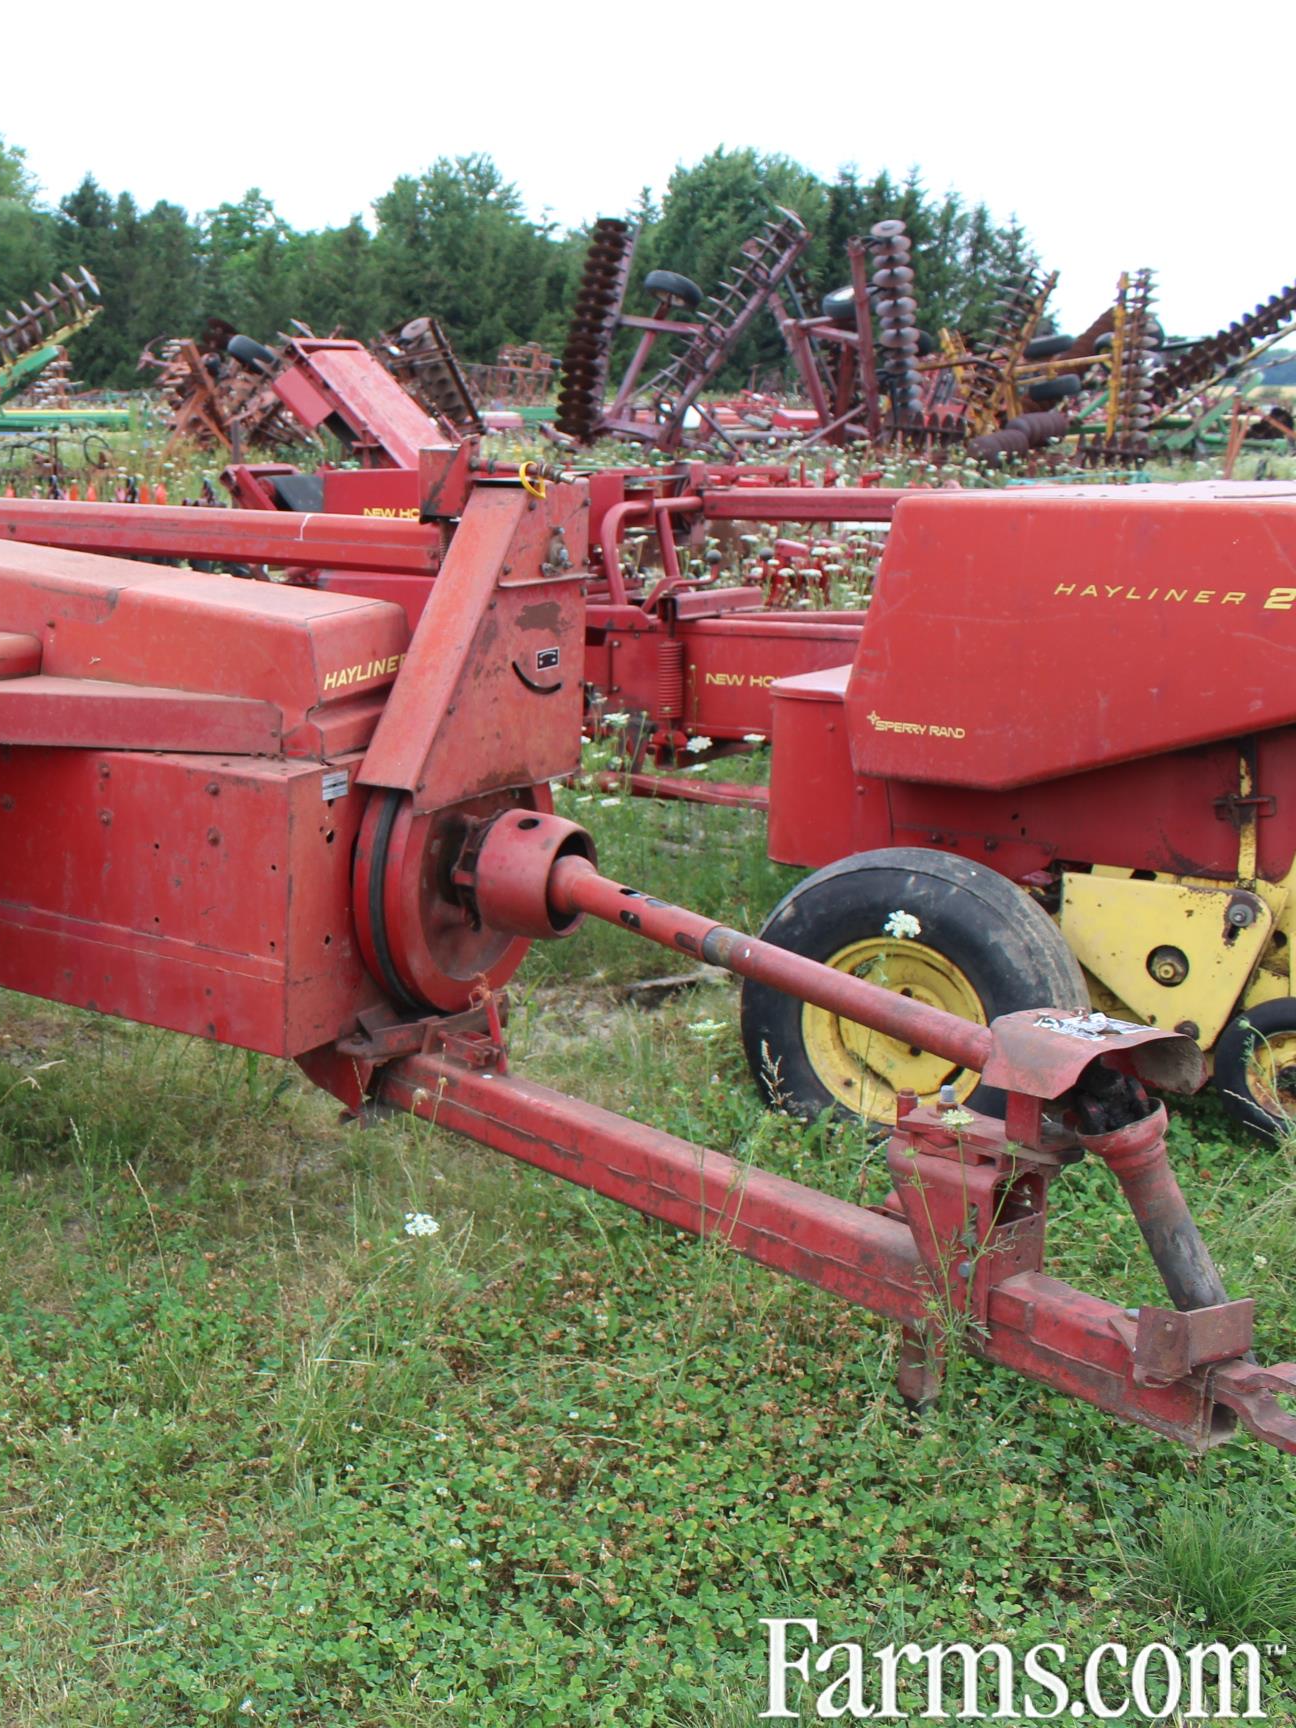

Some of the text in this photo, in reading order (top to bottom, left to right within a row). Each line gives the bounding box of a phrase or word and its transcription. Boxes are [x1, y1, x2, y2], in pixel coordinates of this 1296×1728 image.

[363, 508, 396, 518] NEW
[1054, 583, 1247, 605] HAYLINER
[705, 673, 745, 686] NEW
[874, 720, 966, 739] SPERRY RAND
